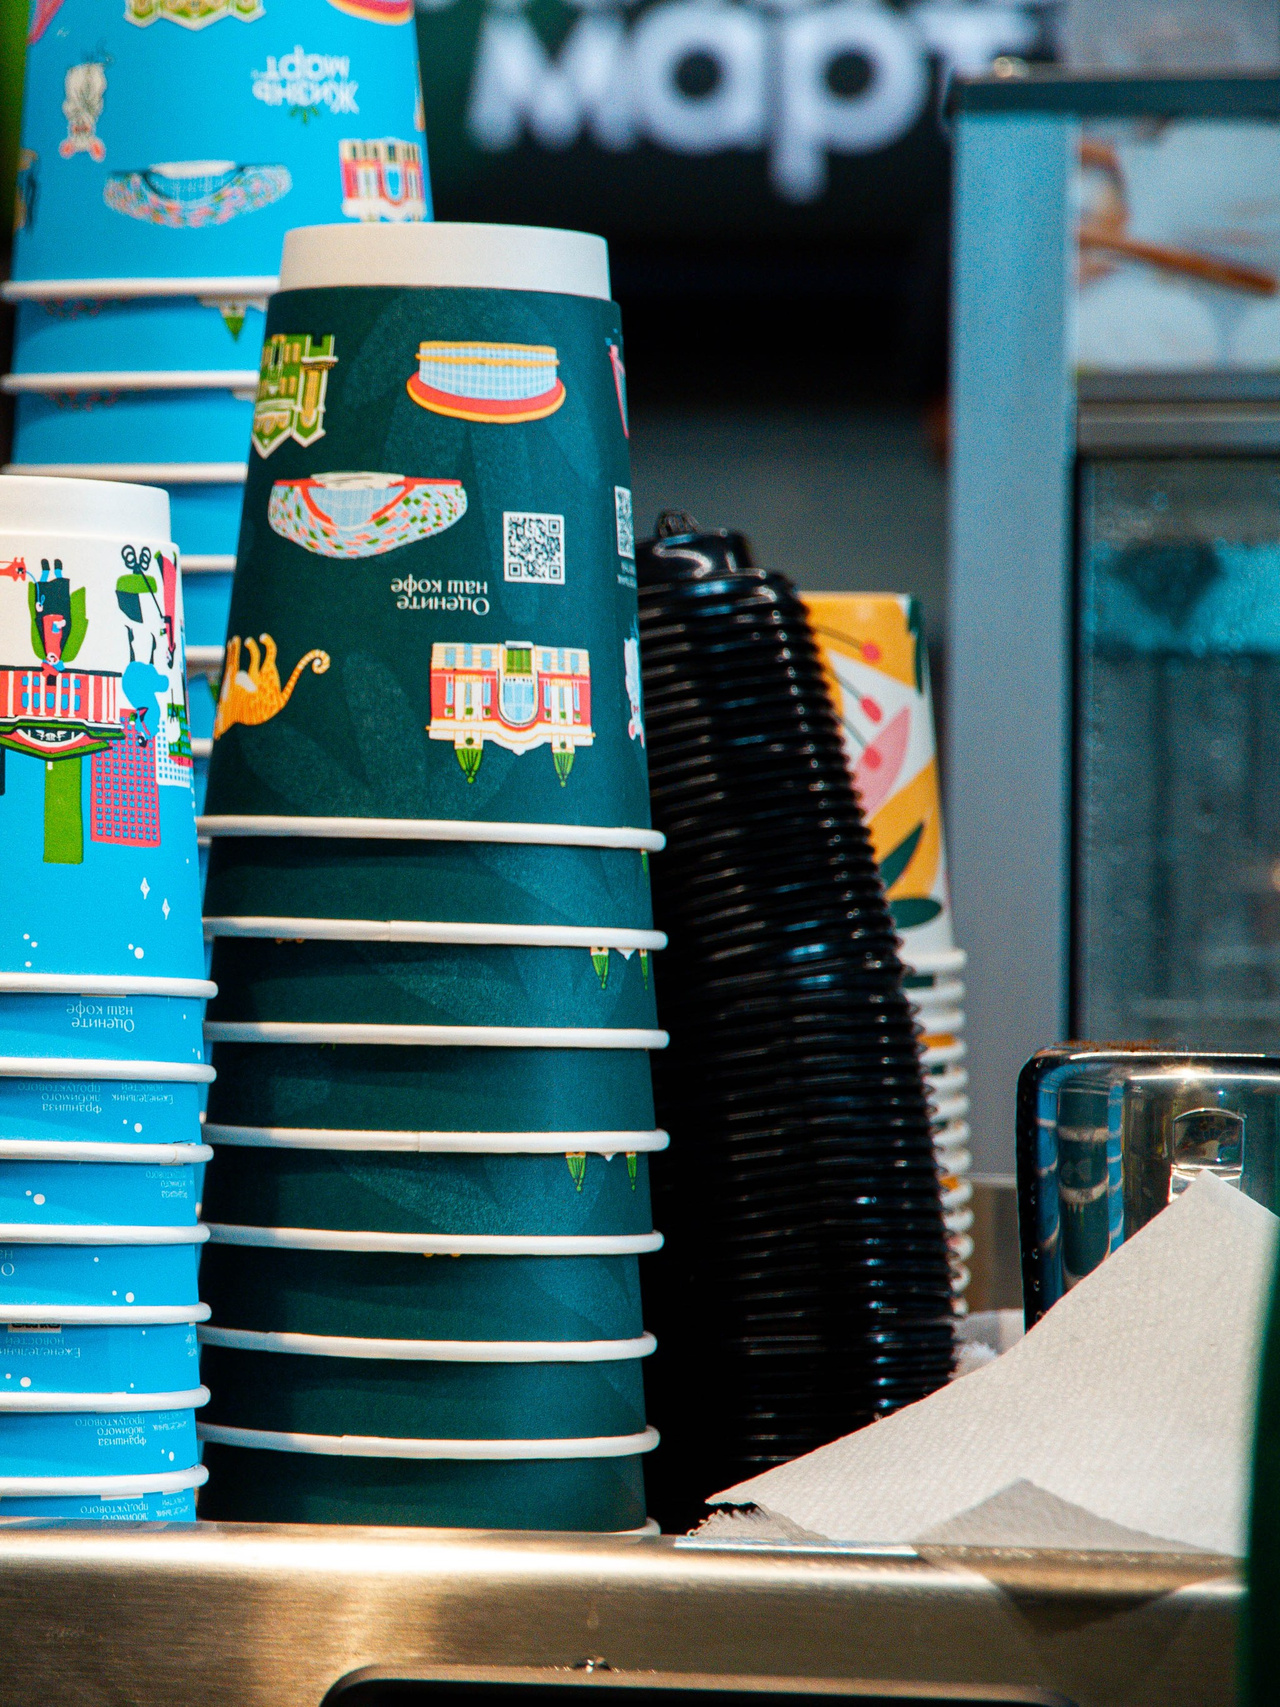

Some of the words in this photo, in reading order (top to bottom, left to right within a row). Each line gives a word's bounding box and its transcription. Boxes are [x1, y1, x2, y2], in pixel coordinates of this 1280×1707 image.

[390, 574, 441, 597] кофе
[448, 579, 488, 595] наш
[396, 595, 490, 617] Оцените
[66, 1000, 103, 1018] кофе
[107, 1006, 134, 1016] наш
[71, 1017, 135, 1033] Оцените
[41, 1092, 102, 1104] любимого
[42, 1102, 103, 1114] Франшиза
[74, 1415, 146, 1427] продуктового
[96, 1426, 146, 1437] любимого
[98, 1434, 147, 1447] Франшиза
[80, 1501, 149, 1514] продуктового
